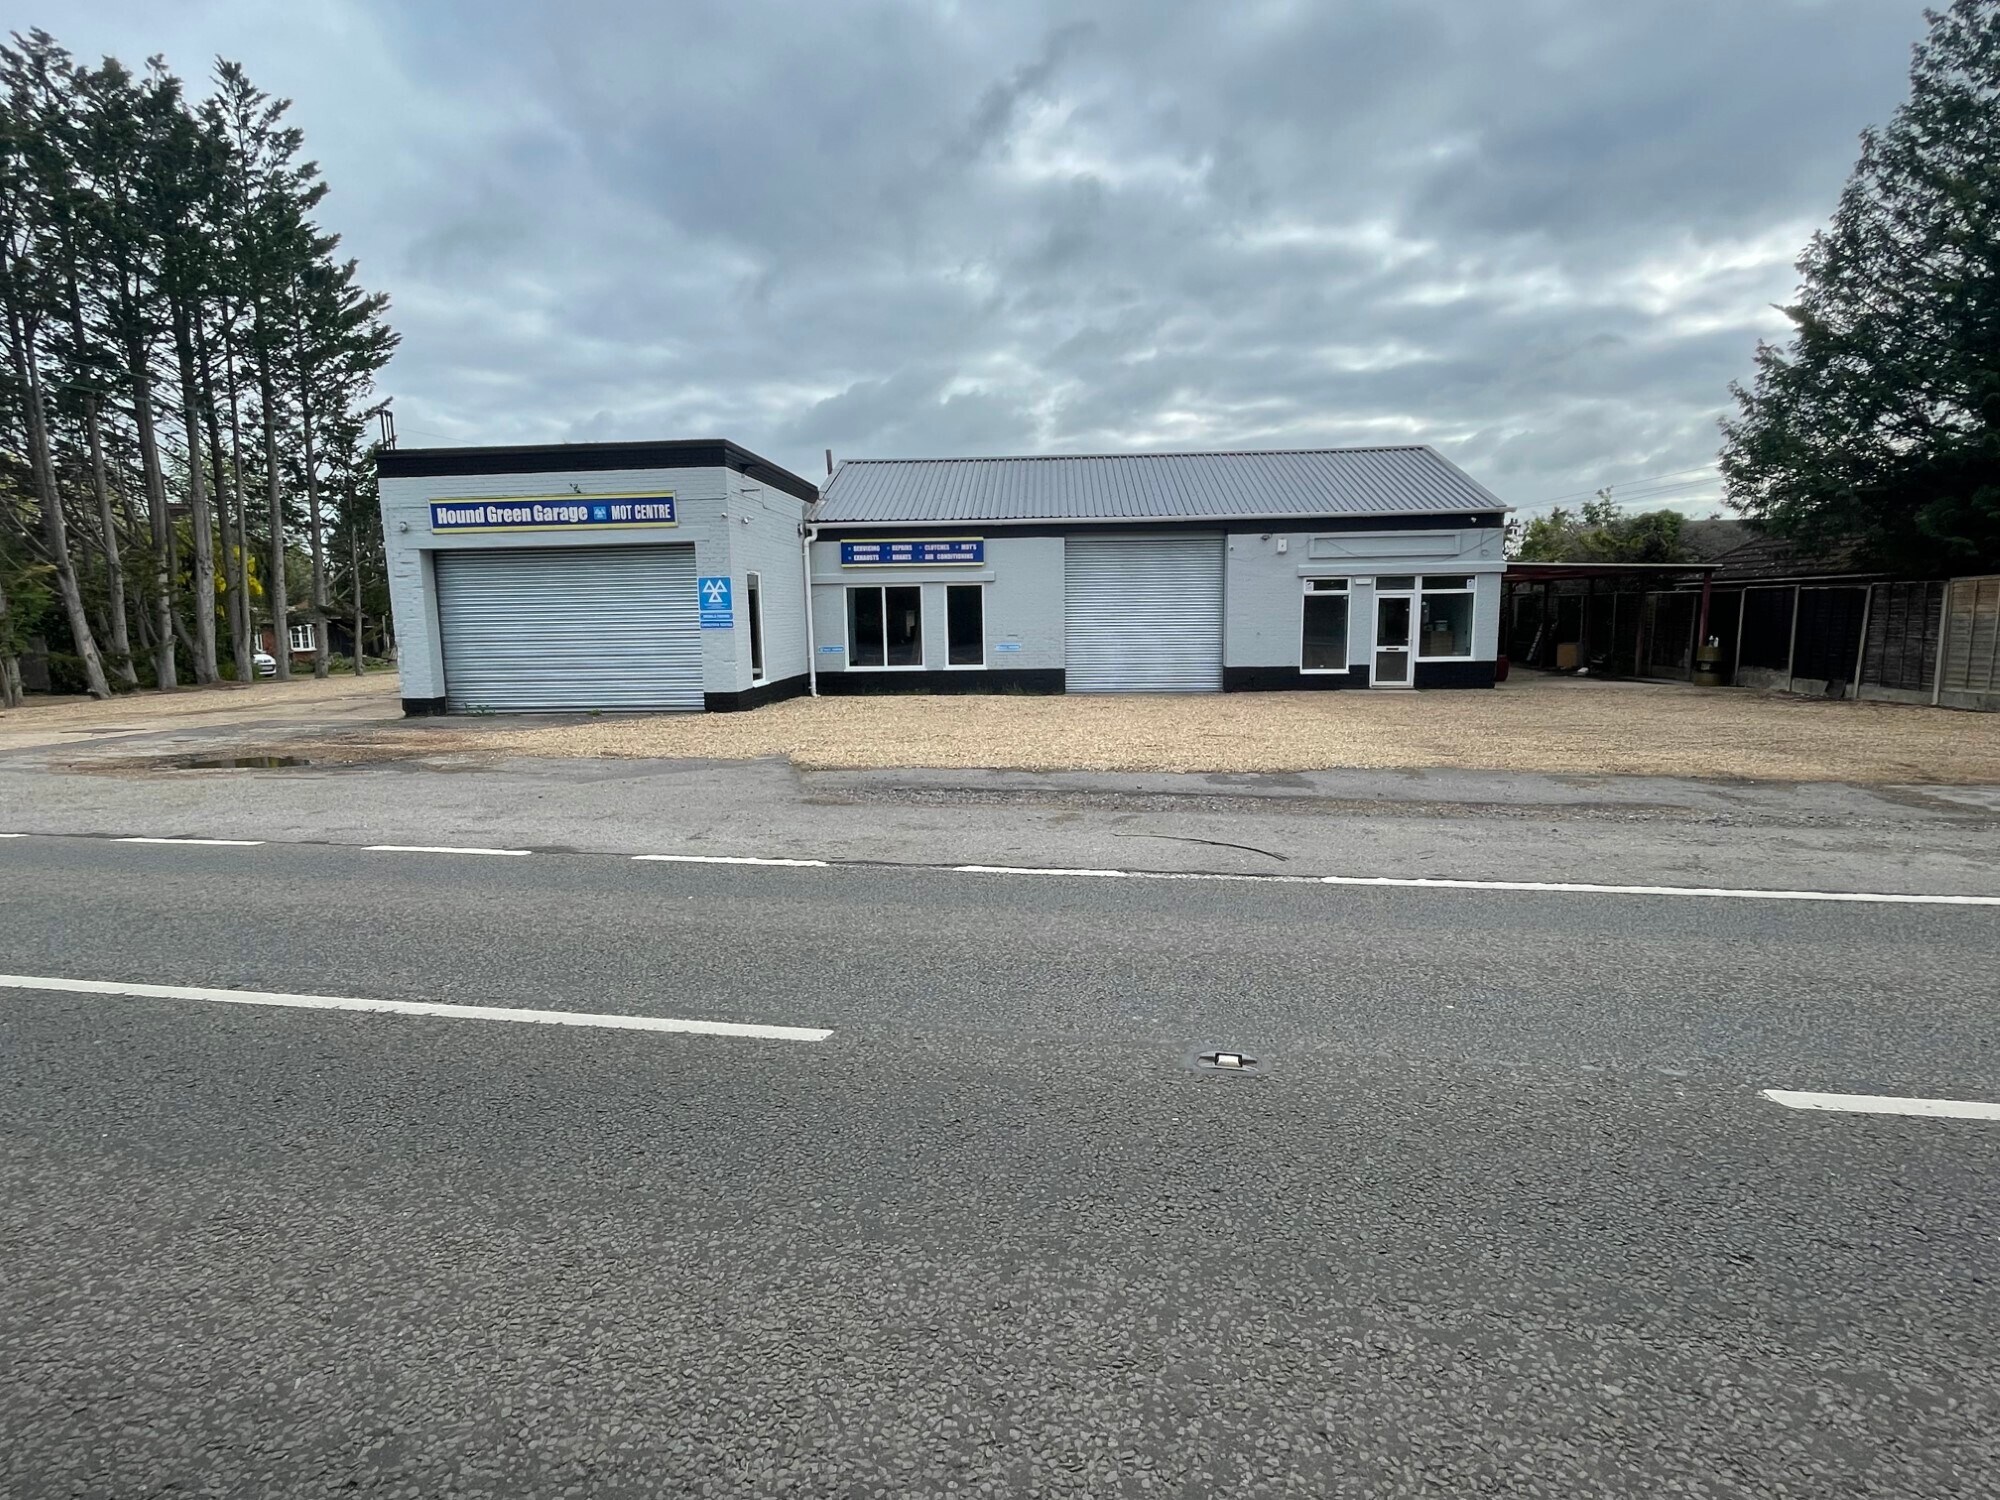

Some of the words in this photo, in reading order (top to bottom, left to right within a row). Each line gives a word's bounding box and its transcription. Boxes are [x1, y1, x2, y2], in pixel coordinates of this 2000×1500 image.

[437, 507, 485, 524] Hound
[487, 506, 530, 523] Green
[533, 504, 588, 522] Garage
[611, 505, 632, 520] MOT
[634, 503, 671, 519] CENTRE
